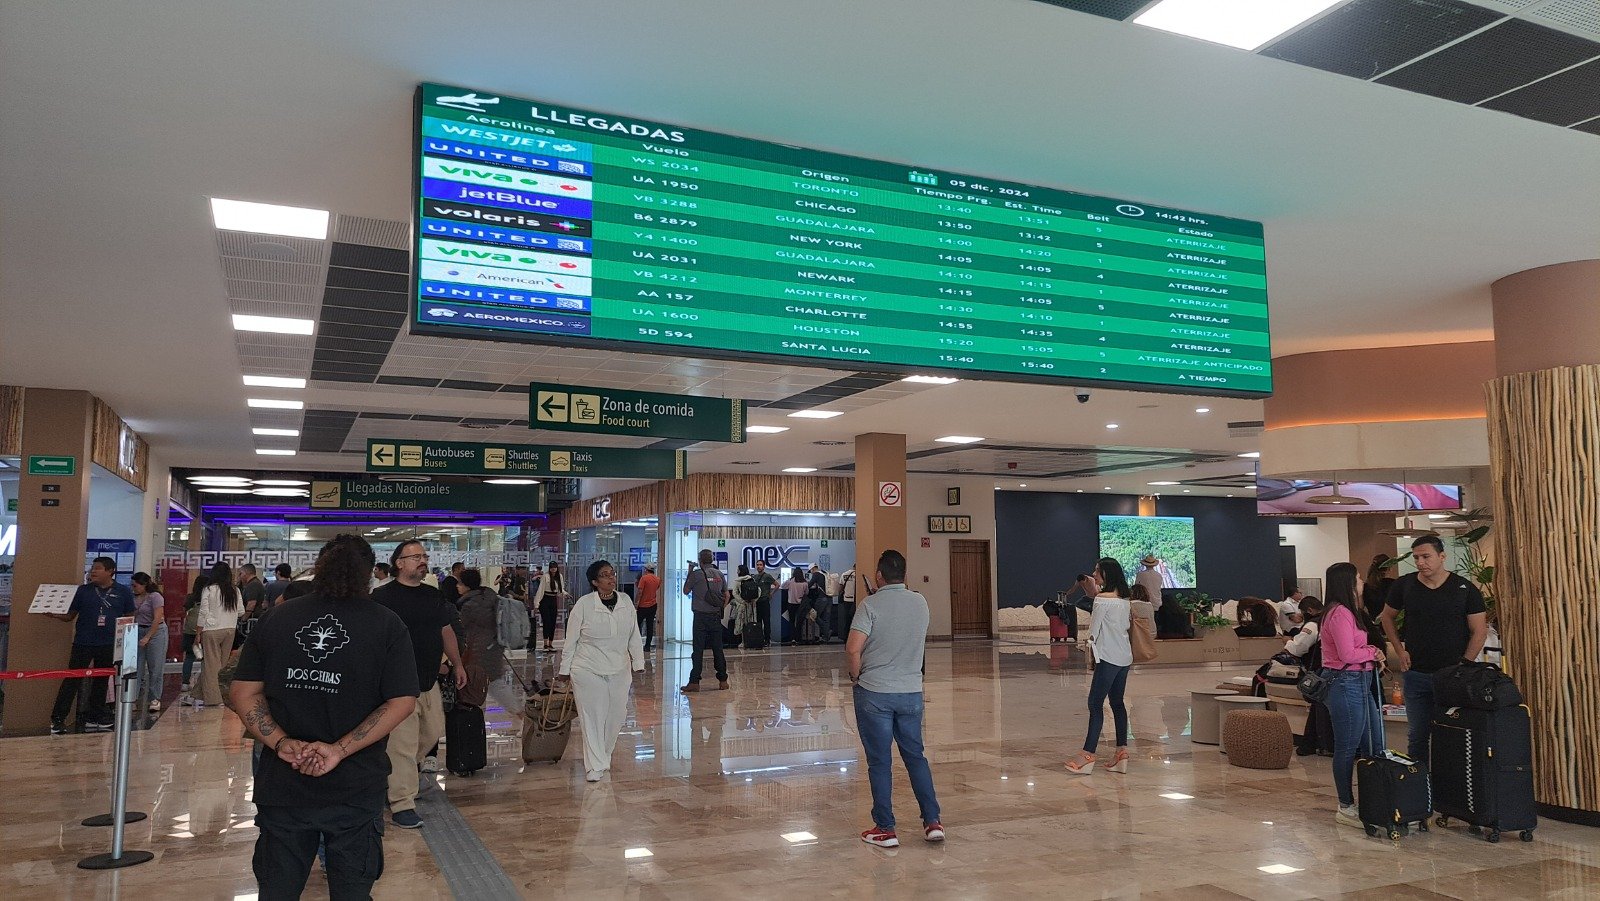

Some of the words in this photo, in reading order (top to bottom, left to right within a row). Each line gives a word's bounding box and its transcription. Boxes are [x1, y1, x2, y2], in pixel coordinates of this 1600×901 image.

[531, 107, 685, 142] LLEGADAS
[441, 124, 550, 148] WESTJET
[430, 142, 549, 166] UNITED
[642, 144, 689, 156] Vuelo
[632, 156, 655, 165] WS
[661, 161, 698, 172] 2034
[438, 165, 512, 182] viva
[802, 169, 849, 182] Origen
[633, 175, 654, 184] UA
[661, 180, 698, 191] 1950
[950, 179, 965, 188] 05
[970, 182, 993, 192] dic,
[999, 187, 1029, 198] 2024
[792, 182, 859, 197] TORONTO
[459, 187, 557, 208] jetBlue
[633, 194, 654, 202] VB
[660, 198, 698, 209] 3288
[914, 187, 962, 200] Tiempo
[968, 196, 992, 205] Prg.
[795, 200, 856, 214] CHICAGO
[938, 203, 972, 214] 13:40
[1005, 202, 1027, 210] Est.
[1032, 205, 1062, 215] Time
[434, 206, 540, 226] volaris
[634, 212, 653, 221] B6
[660, 216, 698, 227] 2879
[1018, 216, 1050, 225] 13:51
[1087, 213, 1110, 222] Belt
[1156, 212, 1186, 222] 14:42
[1188, 216, 1208, 225] hrs.
[776, 216, 875, 234] GUADALAJARA
[938, 220, 972, 230] 13:50
[428, 224, 549, 244] UNITED
[1018, 232, 1050, 241] 13:42
[1178, 227, 1213, 238] Estado
[633, 232, 653, 240] Y4
[660, 235, 698, 246] 1400
[790, 234, 821, 244] NEW
[826, 238, 862, 250] YORK
[938, 237, 972, 247] 14:00
[1166, 238, 1226, 250] ATERRIZAJE
[436, 246, 511, 262] viva
[632, 250, 654, 259] UA
[660, 254, 698, 264] 2031
[938, 254, 972, 263] 14:05
[1019, 248, 1051, 257] 14:20
[776, 250, 875, 268] GUADALAJARA
[1166, 253, 1227, 265] ATERRIZAJE
[1020, 264, 1051, 273] 14:05
[1167, 268, 1228, 280] ATERRIZAJE
[477, 273, 544, 286] American
[633, 270, 654, 278] VB
[660, 272, 698, 282] 4212
[798, 271, 856, 284] NEWARK
[938, 271, 972, 279] 14:10
[1020, 280, 1051, 288] 14:15
[1168, 282, 1228, 294] ATERRIZAJE
[426, 286, 548, 304] UNITED
[666, 292, 692, 301] 157
[784, 288, 867, 302] MONTERREY
[938, 287, 972, 296] 14:15
[1020, 297, 1052, 305] 14:05
[1169, 298, 1229, 309] ATERRIZAJE
[786, 306, 866, 320] CHARLOTTE
[939, 304, 973, 312] 14:30
[464, 312, 564, 327] AEROMEXICO
[632, 308, 654, 316] UA
[661, 311, 698, 321] 1600
[1169, 313, 1229, 324] ATERRIZAJE
[793, 324, 860, 336] HOUSTON
[939, 321, 973, 329] 14:55
[638, 328, 658, 336] 5D
[664, 330, 693, 338] 594
[1170, 328, 1230, 338] ATERRIZAJE
[782, 341, 827, 351] SANTA
[832, 345, 870, 355] LUCIA
[939, 338, 974, 346] 15:20
[1171, 343, 1231, 353] ATERRIZAJE
[939, 354, 974, 363] 15:40
[1138, 355, 1200, 366] ATERRIZAJE
[1204, 362, 1263, 371] ANTICIPADO
[1188, 375, 1226, 383] TIEMPO
[603, 397, 631, 412] Zona
[635, 398, 650, 413] de
[652, 402, 694, 416] comida
[602, 415, 624, 426] Food
[626, 418, 650, 428] court
[425, 446, 474, 458] Autobuses
[508, 450, 538, 460] Shuttles
[572, 452, 592, 462] Taxis
[424, 458, 446, 468] Buses
[508, 461, 538, 470] Shuttles
[573, 464, 588, 472] Taxis
[347, 482, 393, 495] Llegadas
[396, 483, 450, 495] Nacionales
[346, 499, 387, 509] Domestic
[388, 499, 416, 509] arrival
[287, 668, 308, 680] DOS
[310, 670, 341, 684] CEIBAS
